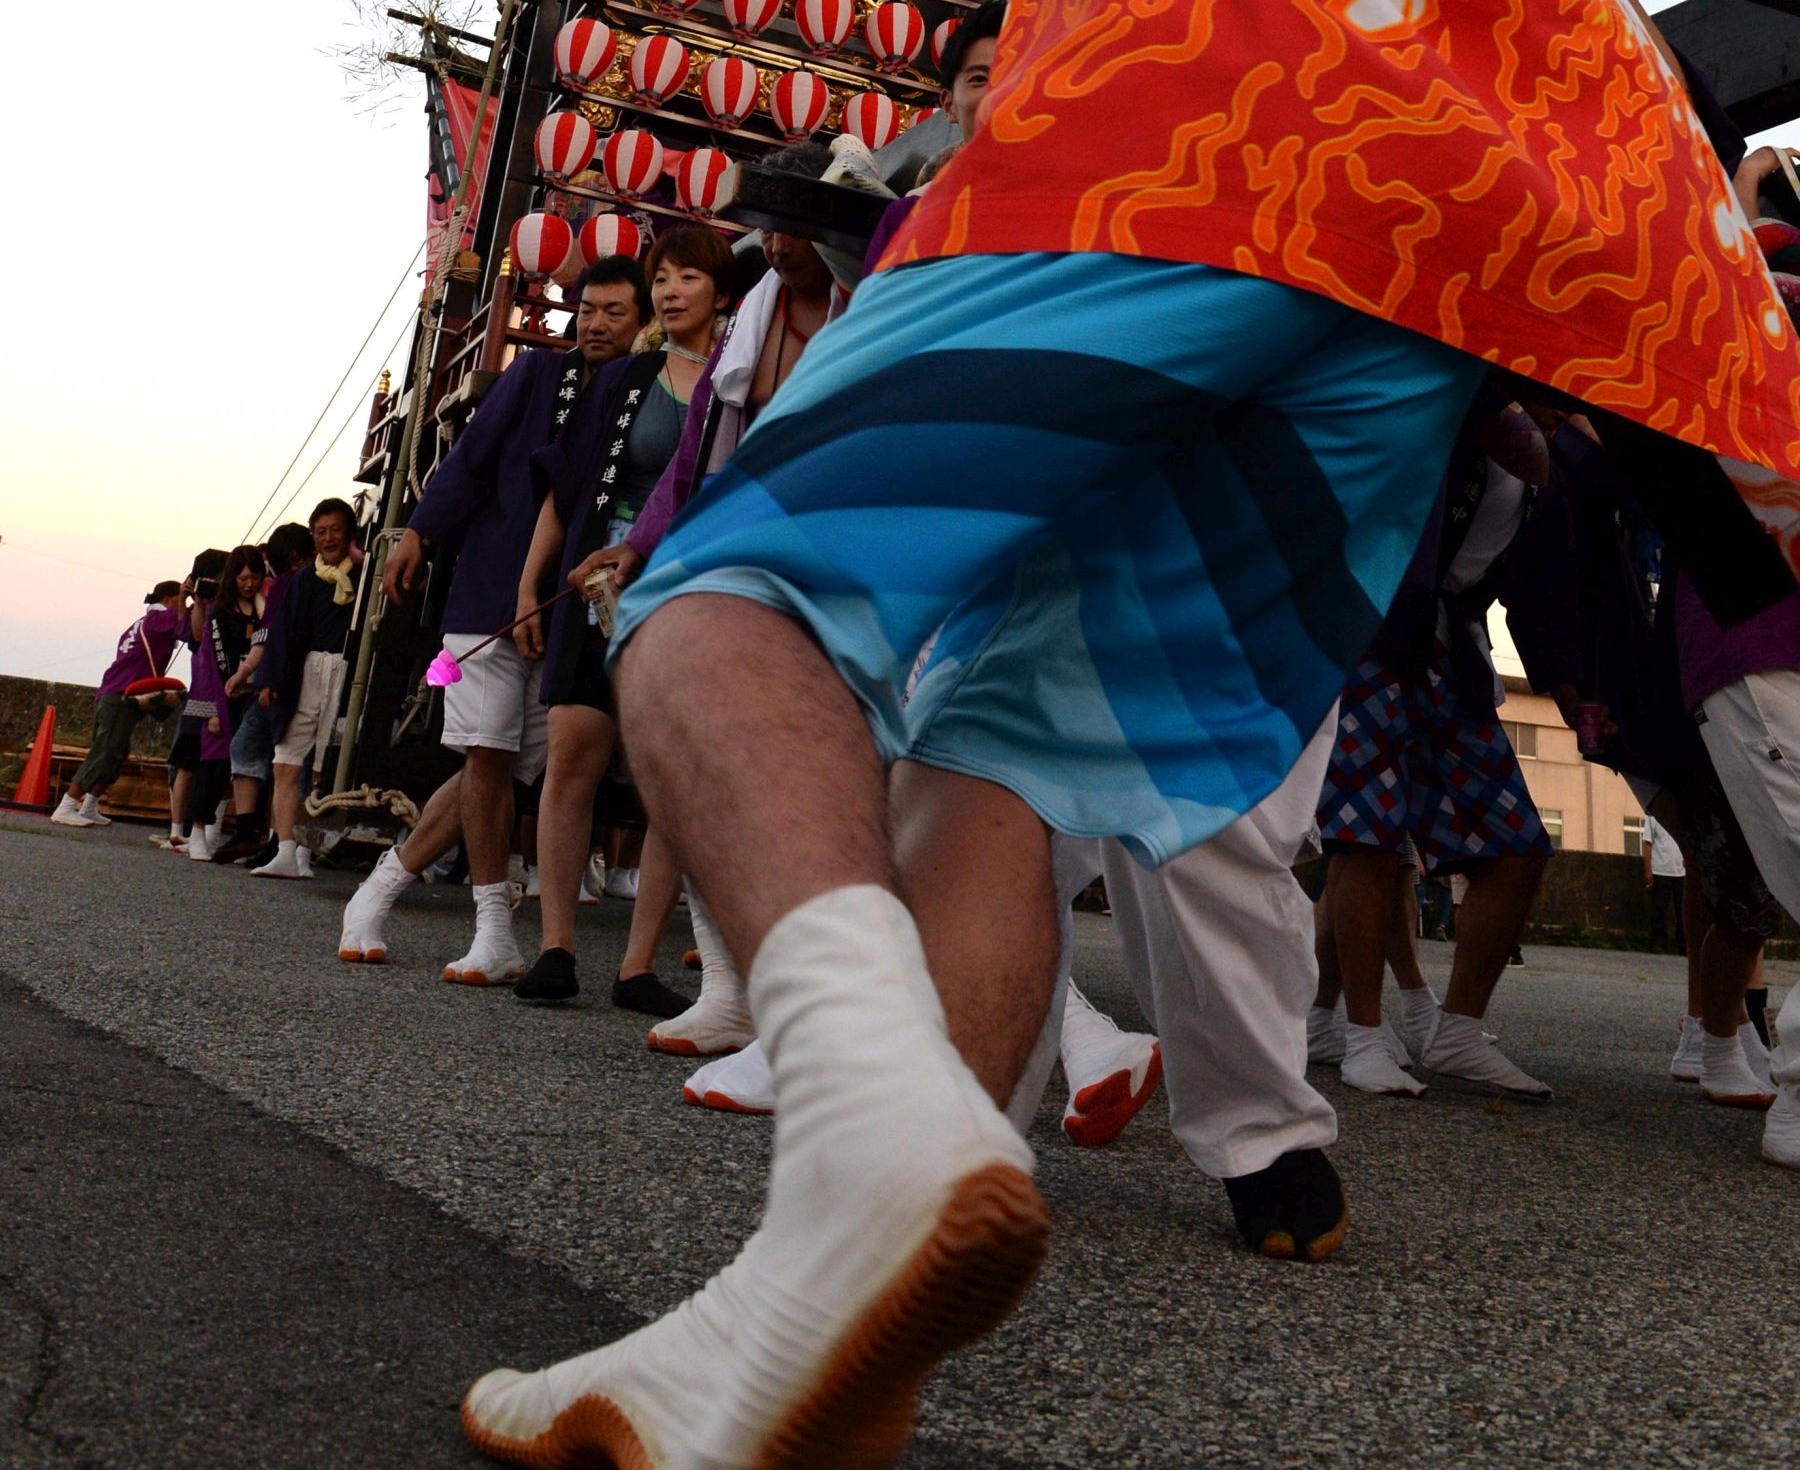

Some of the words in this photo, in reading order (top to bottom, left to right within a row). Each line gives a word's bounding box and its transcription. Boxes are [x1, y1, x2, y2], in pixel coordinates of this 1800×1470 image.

[596, 388, 641, 511] 黒峰若連中
